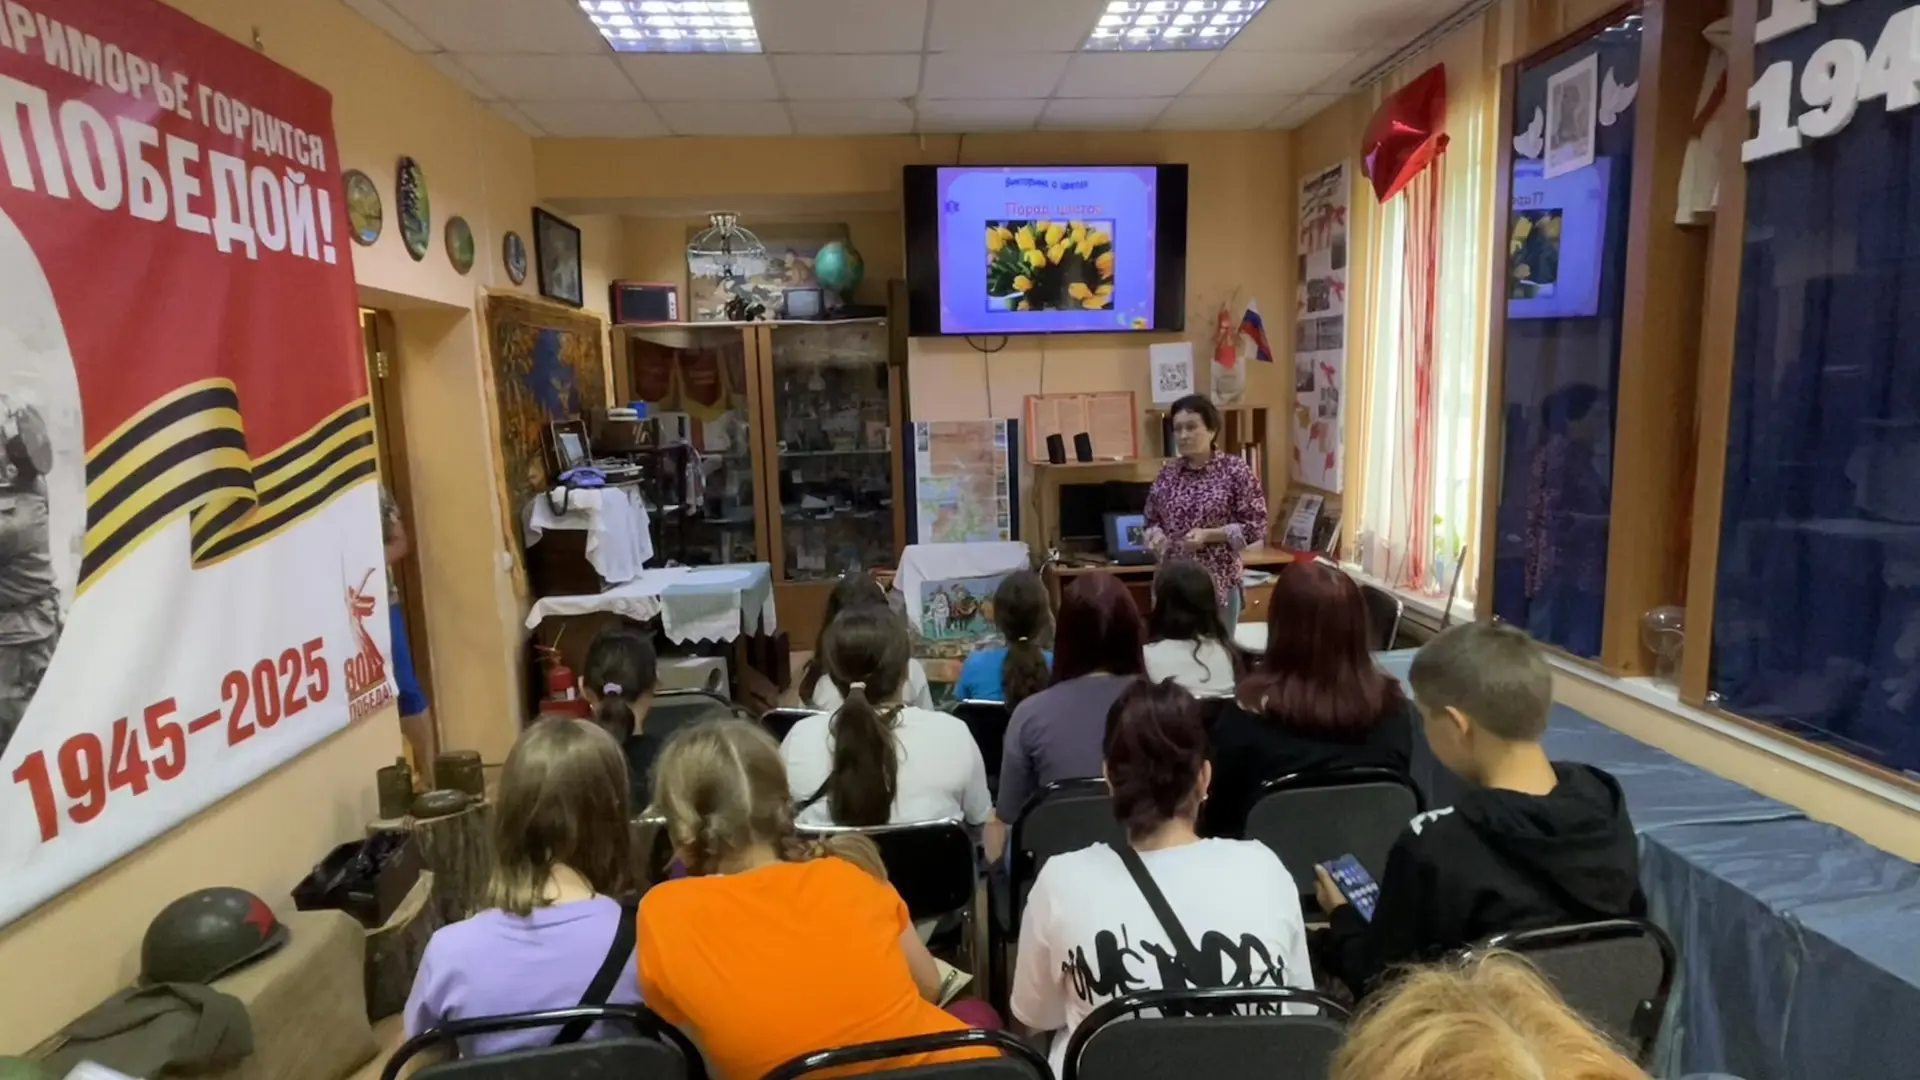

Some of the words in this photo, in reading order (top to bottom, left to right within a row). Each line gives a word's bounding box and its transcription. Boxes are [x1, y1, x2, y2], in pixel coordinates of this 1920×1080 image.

[0, 74, 337, 265] ПОБЕДОЙ!
[198, 84, 326, 172] ГОРДИТСЯ
[350, 682, 394, 721] ПОБЕДА!
